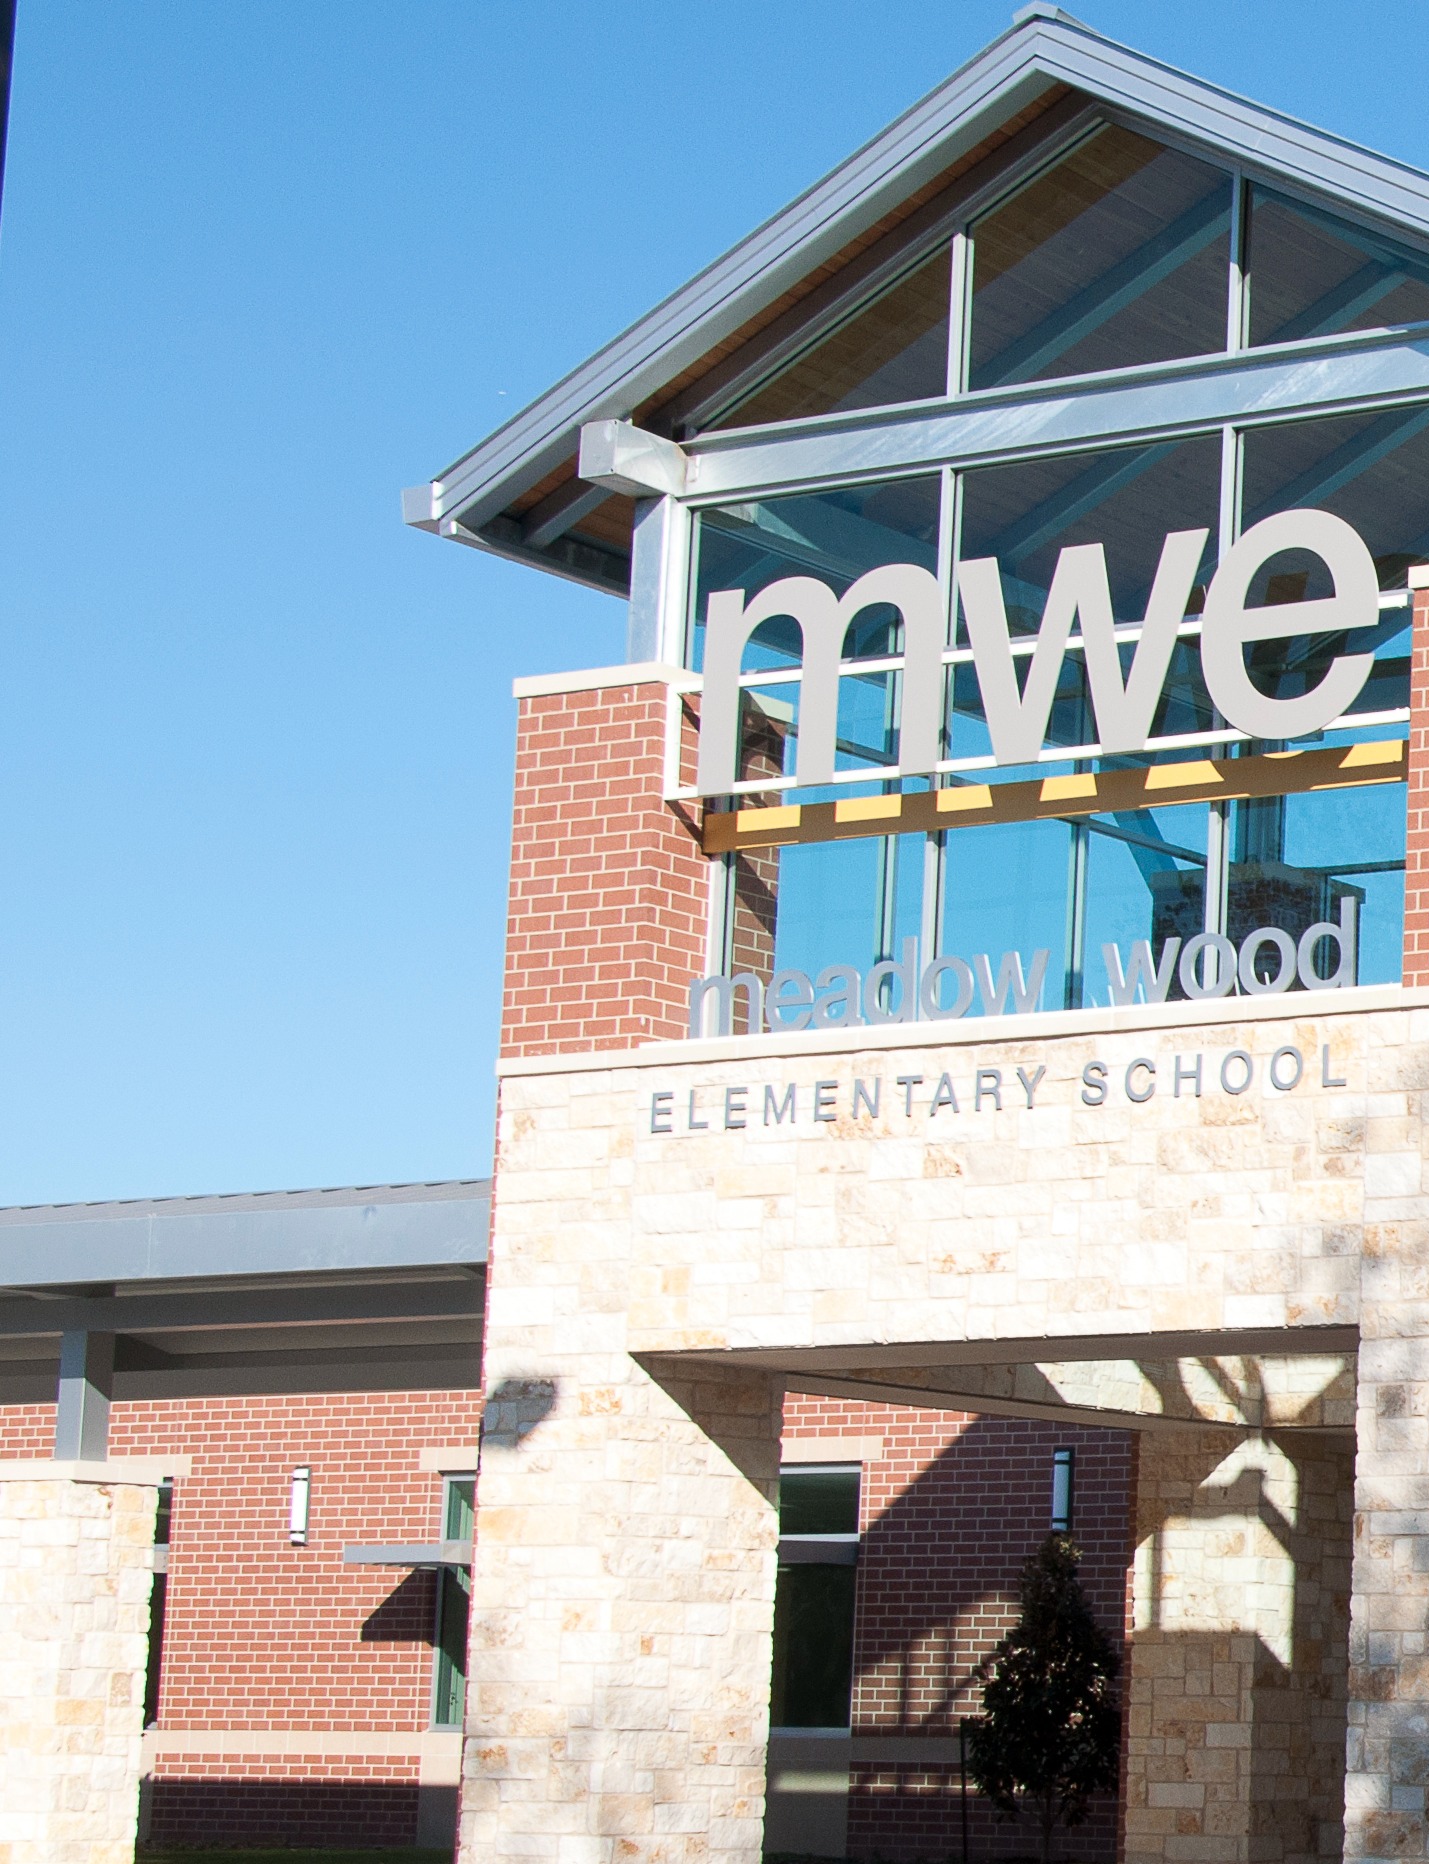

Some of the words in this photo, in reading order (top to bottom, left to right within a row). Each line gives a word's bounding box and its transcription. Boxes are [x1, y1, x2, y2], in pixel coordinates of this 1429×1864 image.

[697, 508, 1379, 798] mwe
[689, 935, 1050, 1039] meadow
[1102, 896, 1360, 1006] wood
[651, 1065, 1046, 1133] ELEMENTARY
[1081, 1044, 1347, 1106] SCHOOL
